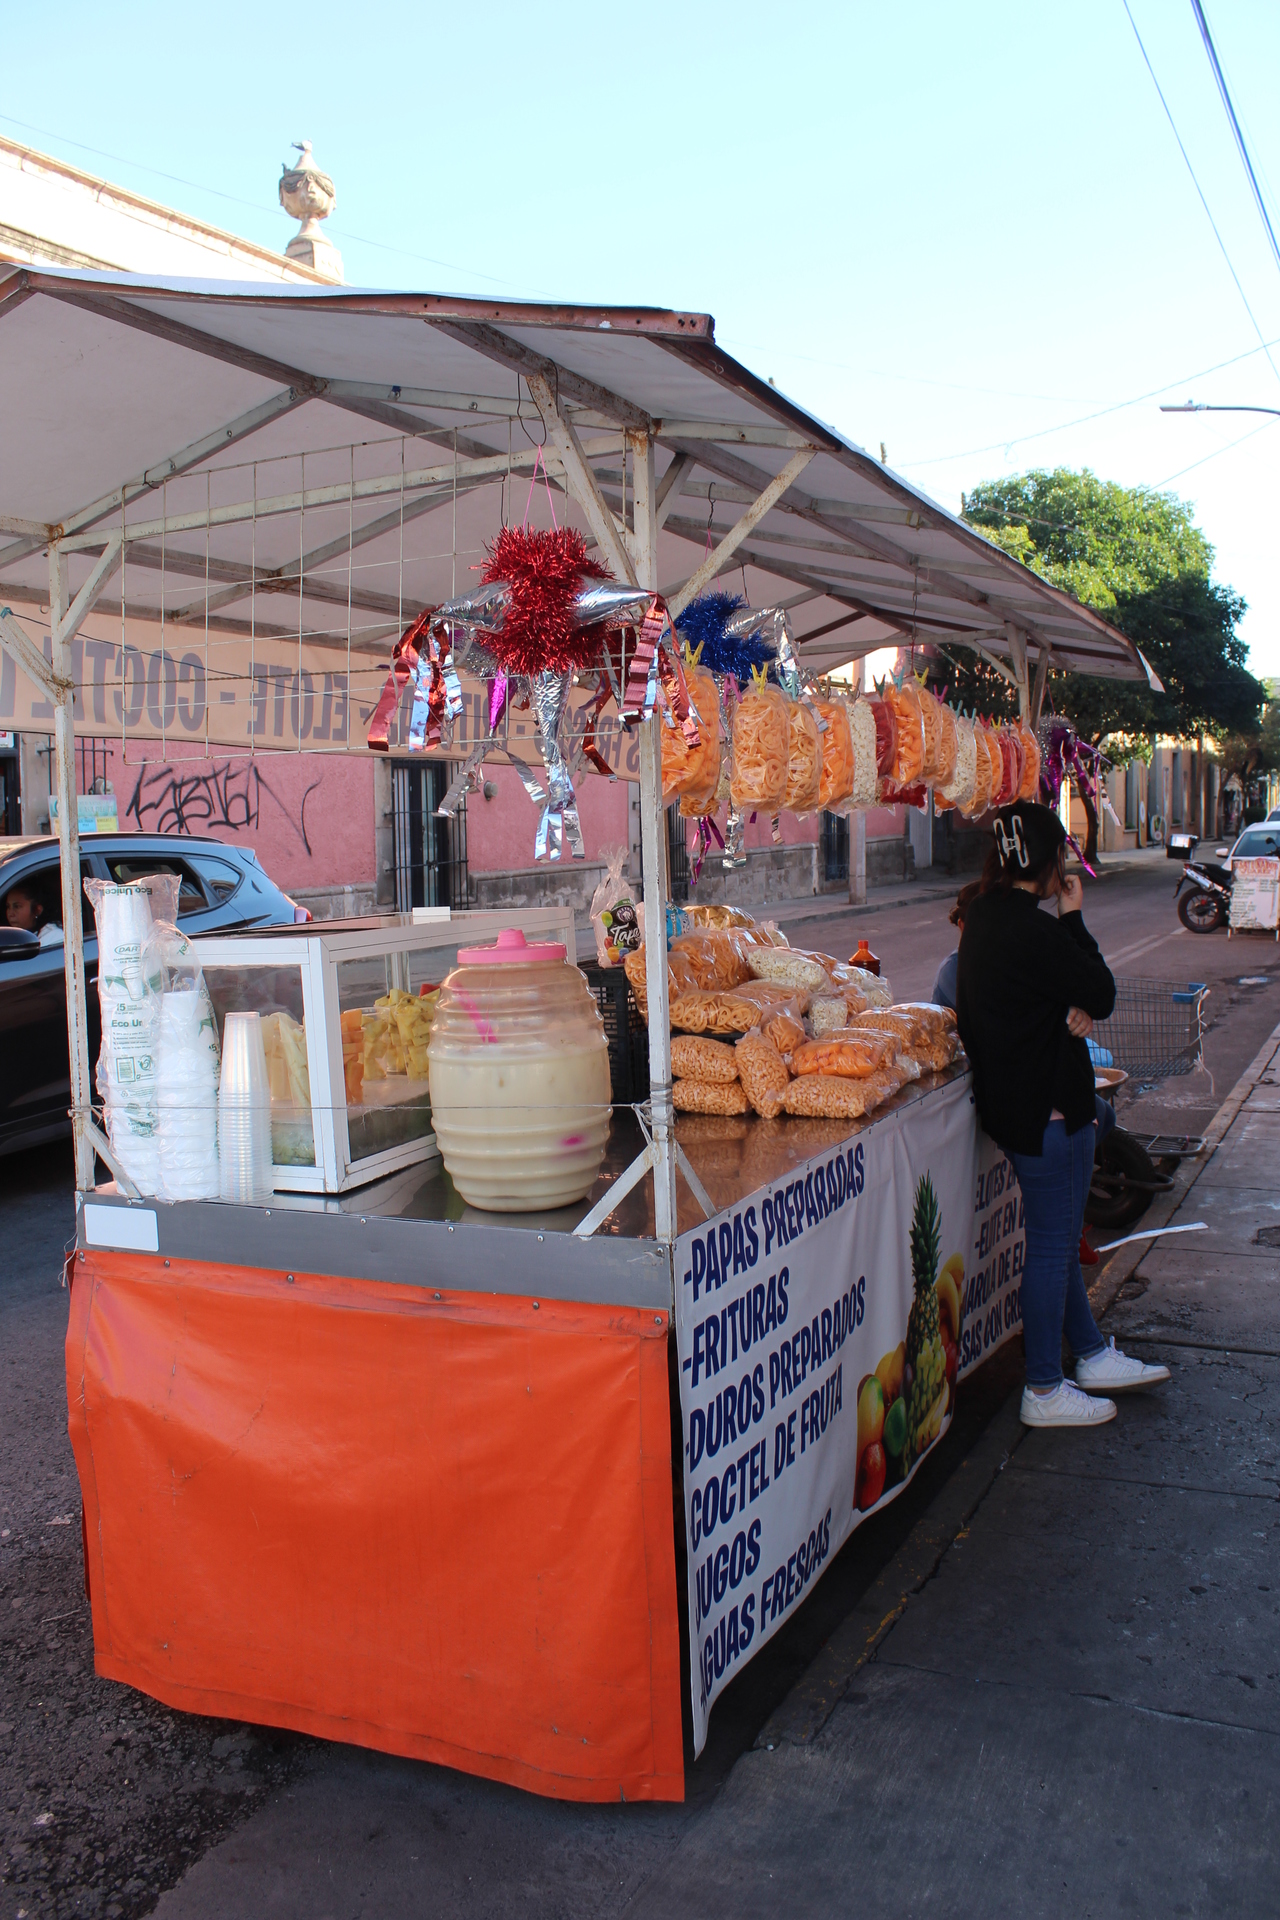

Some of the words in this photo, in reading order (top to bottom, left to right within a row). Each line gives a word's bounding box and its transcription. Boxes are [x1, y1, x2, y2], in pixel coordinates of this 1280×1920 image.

[135, 887, 153, 896] Eco
[111, 1019, 129, 1028] Eco
[761, 1142, 865, 1256] PREPARADAS
[1002, 1197, 1018, 1238] EN
[997, 1246, 1012, 1289] DE
[769, 1275, 866, 1409] PREPARADOS
[774, 1404, 796, 1481] DE
[800, 1363, 843, 1454] FRUTA
[694, 1518, 762, 1634] JUGOS
[759, 1508, 832, 1634] FRESCAS
